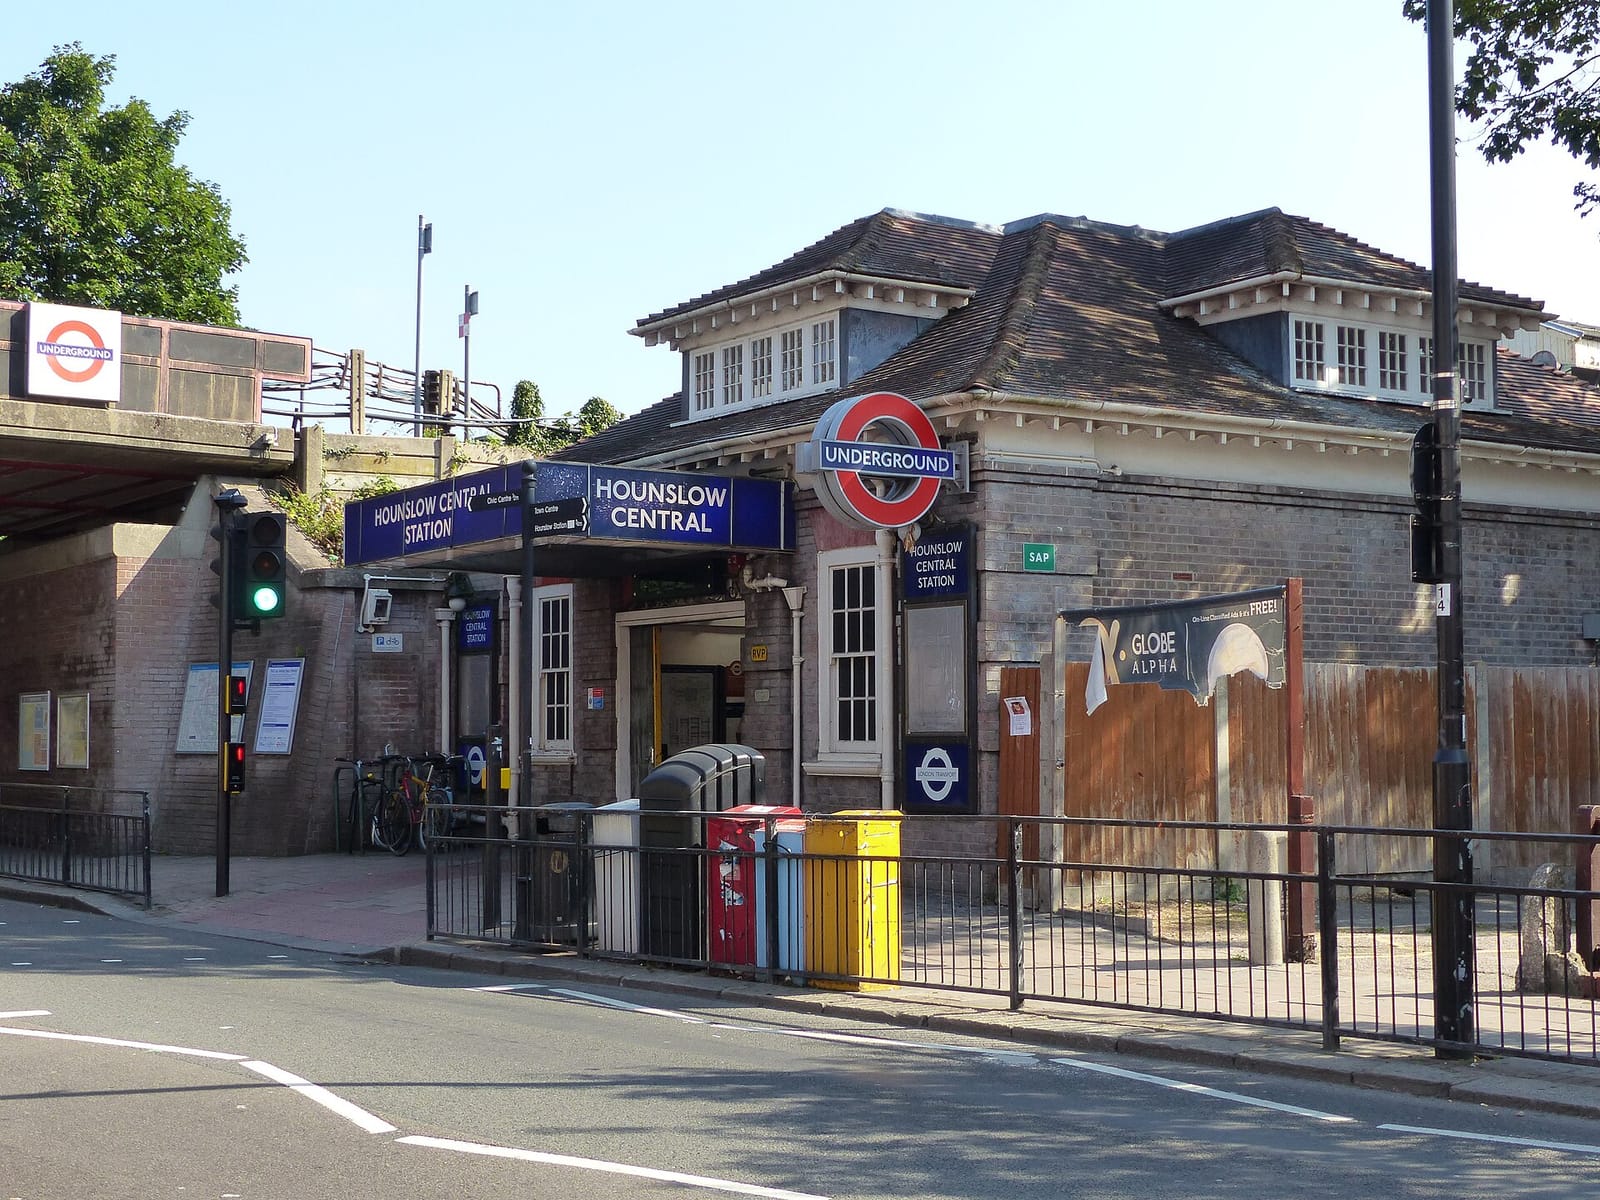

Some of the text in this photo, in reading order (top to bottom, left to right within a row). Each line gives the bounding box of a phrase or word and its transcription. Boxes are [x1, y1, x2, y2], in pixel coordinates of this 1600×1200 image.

[39, 344, 111, 359] UNDERGROUND
[825, 446, 950, 472] UNDERGROUND
[486, 496, 497, 505] Civic
[498, 494, 512, 503] Centre
[596, 478, 727, 508] HOUNSLOW
[374, 495, 436, 527] HOUNSLOW
[534, 505, 559, 515] Town Centre
[534, 524, 553, 532] Hounslow
[553, 521, 568, 530] Station
[611, 506, 713, 533] CENTRAL
[405, 517, 452, 545] STATION
[911, 541, 963, 557] HOUNSLOW
[1029, 552, 1049, 563] SAP
[915, 558, 957, 573] CENTRAL
[918, 574, 955, 589] STATION
[1249, 599, 1278, 616] FREE!
[466, 622, 487, 632] CENTRAL
[467, 633, 486, 643] STATION
[1131, 631, 1176, 655] GLOBE
[752, 648, 766, 659] RVP
[1132, 657, 1177, 675] ALPHA
